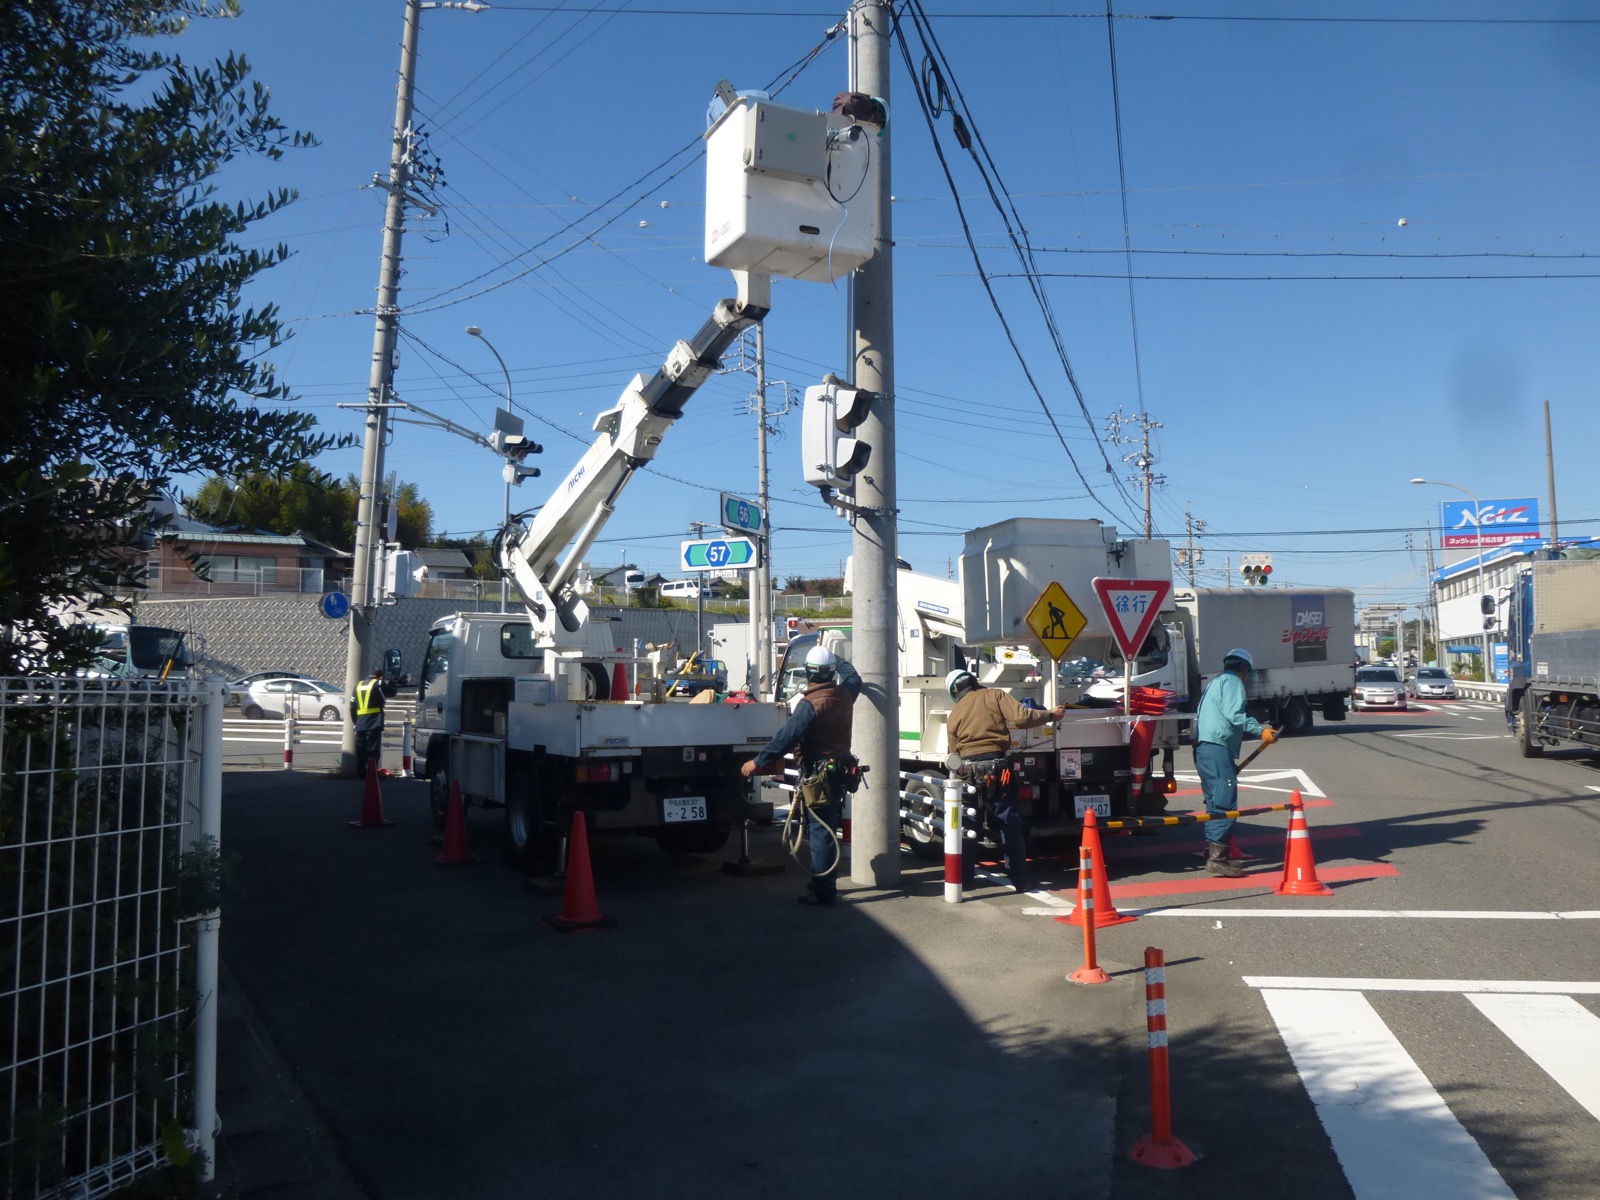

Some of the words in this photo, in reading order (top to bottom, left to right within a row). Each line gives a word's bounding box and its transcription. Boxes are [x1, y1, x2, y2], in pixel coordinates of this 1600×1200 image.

[567, 466, 585, 492] AICHI
[739, 506, 749, 523] 56
[1453, 505, 1529, 529] Netz
[710, 545, 726, 562] 57
[1115, 594, 1147, 613] 徐行
[1295, 610, 1323, 626] DAISEI
